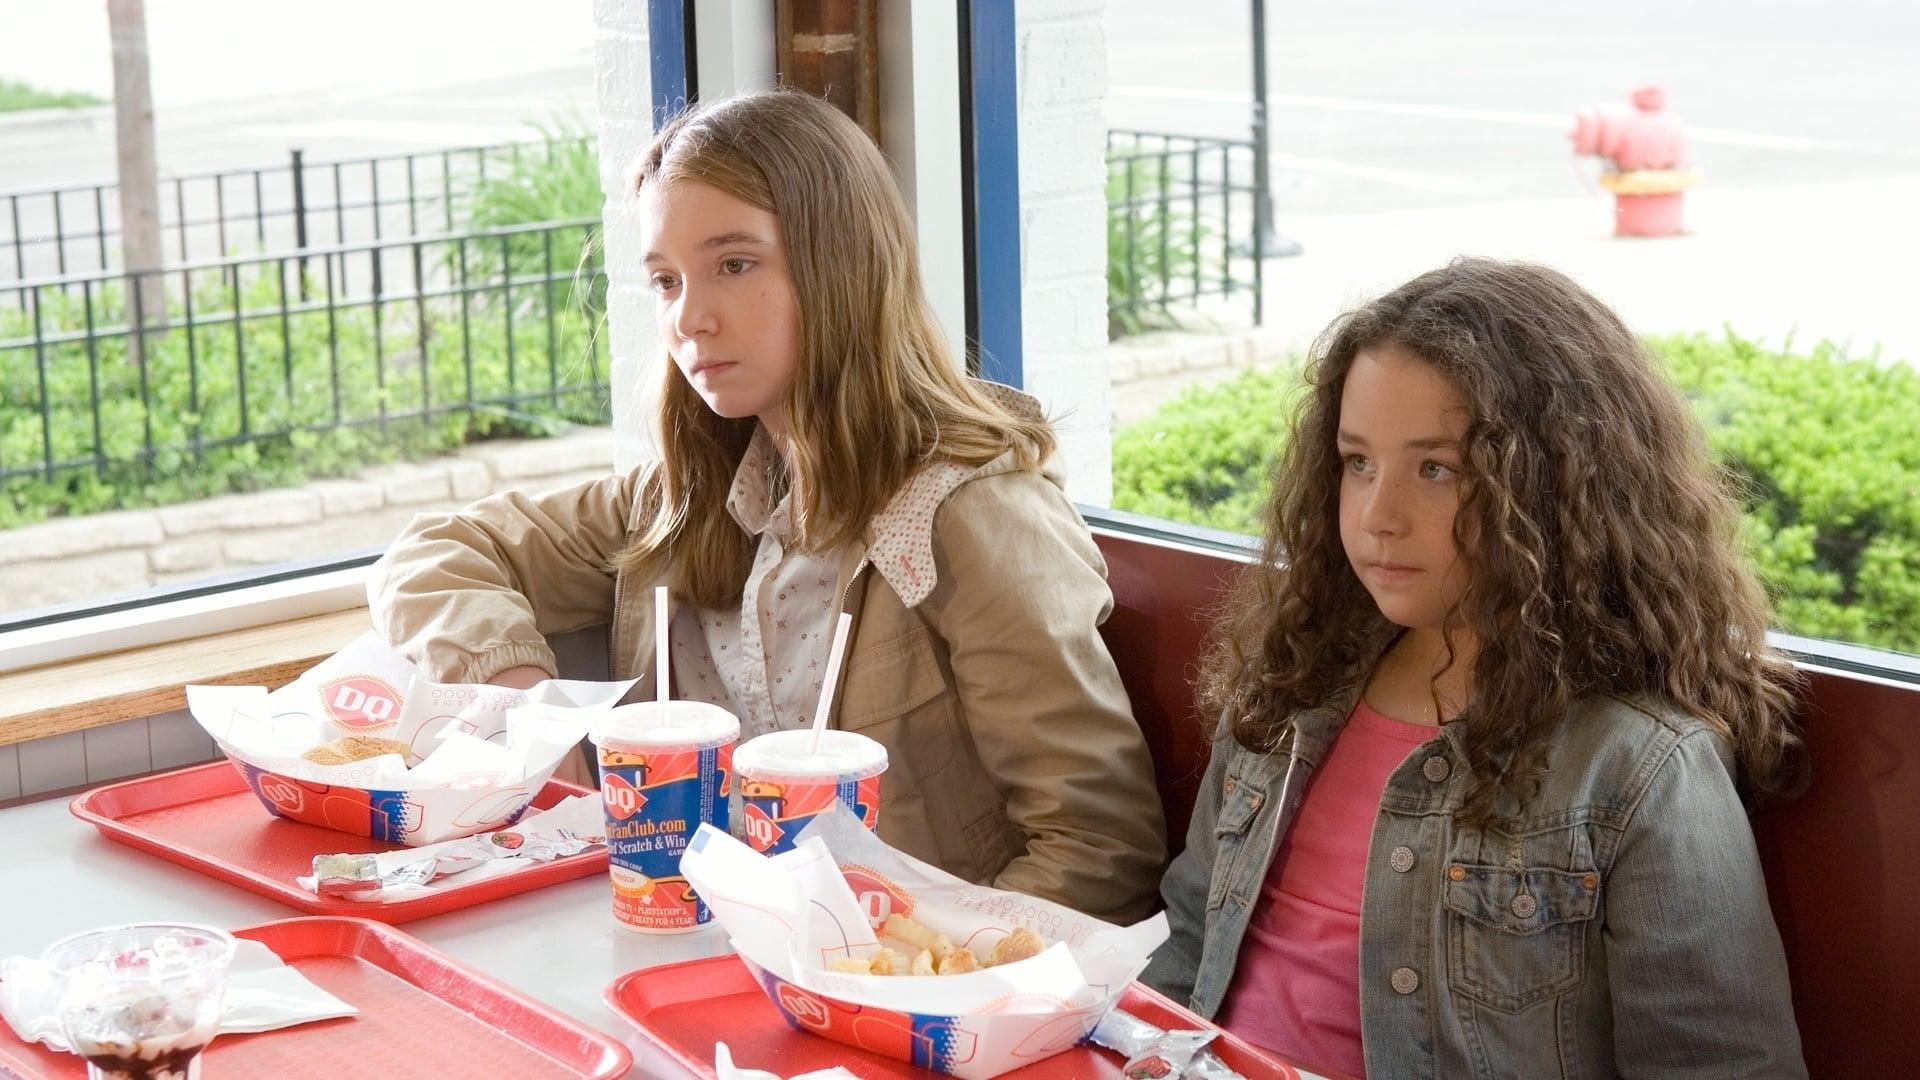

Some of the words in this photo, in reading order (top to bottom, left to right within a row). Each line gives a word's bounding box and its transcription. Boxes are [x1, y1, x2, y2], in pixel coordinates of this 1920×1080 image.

[333, 685, 393, 722] DQ
[264, 784, 298, 804] DQ
[604, 783, 635, 813] DQ
[618, 837, 653, 855] Scratch
[655, 836, 664, 850] &
[665, 834, 686, 848] Win
[745, 813, 772, 846] DQ
[860, 890, 892, 930] Q
[784, 995, 822, 1020] DQ
